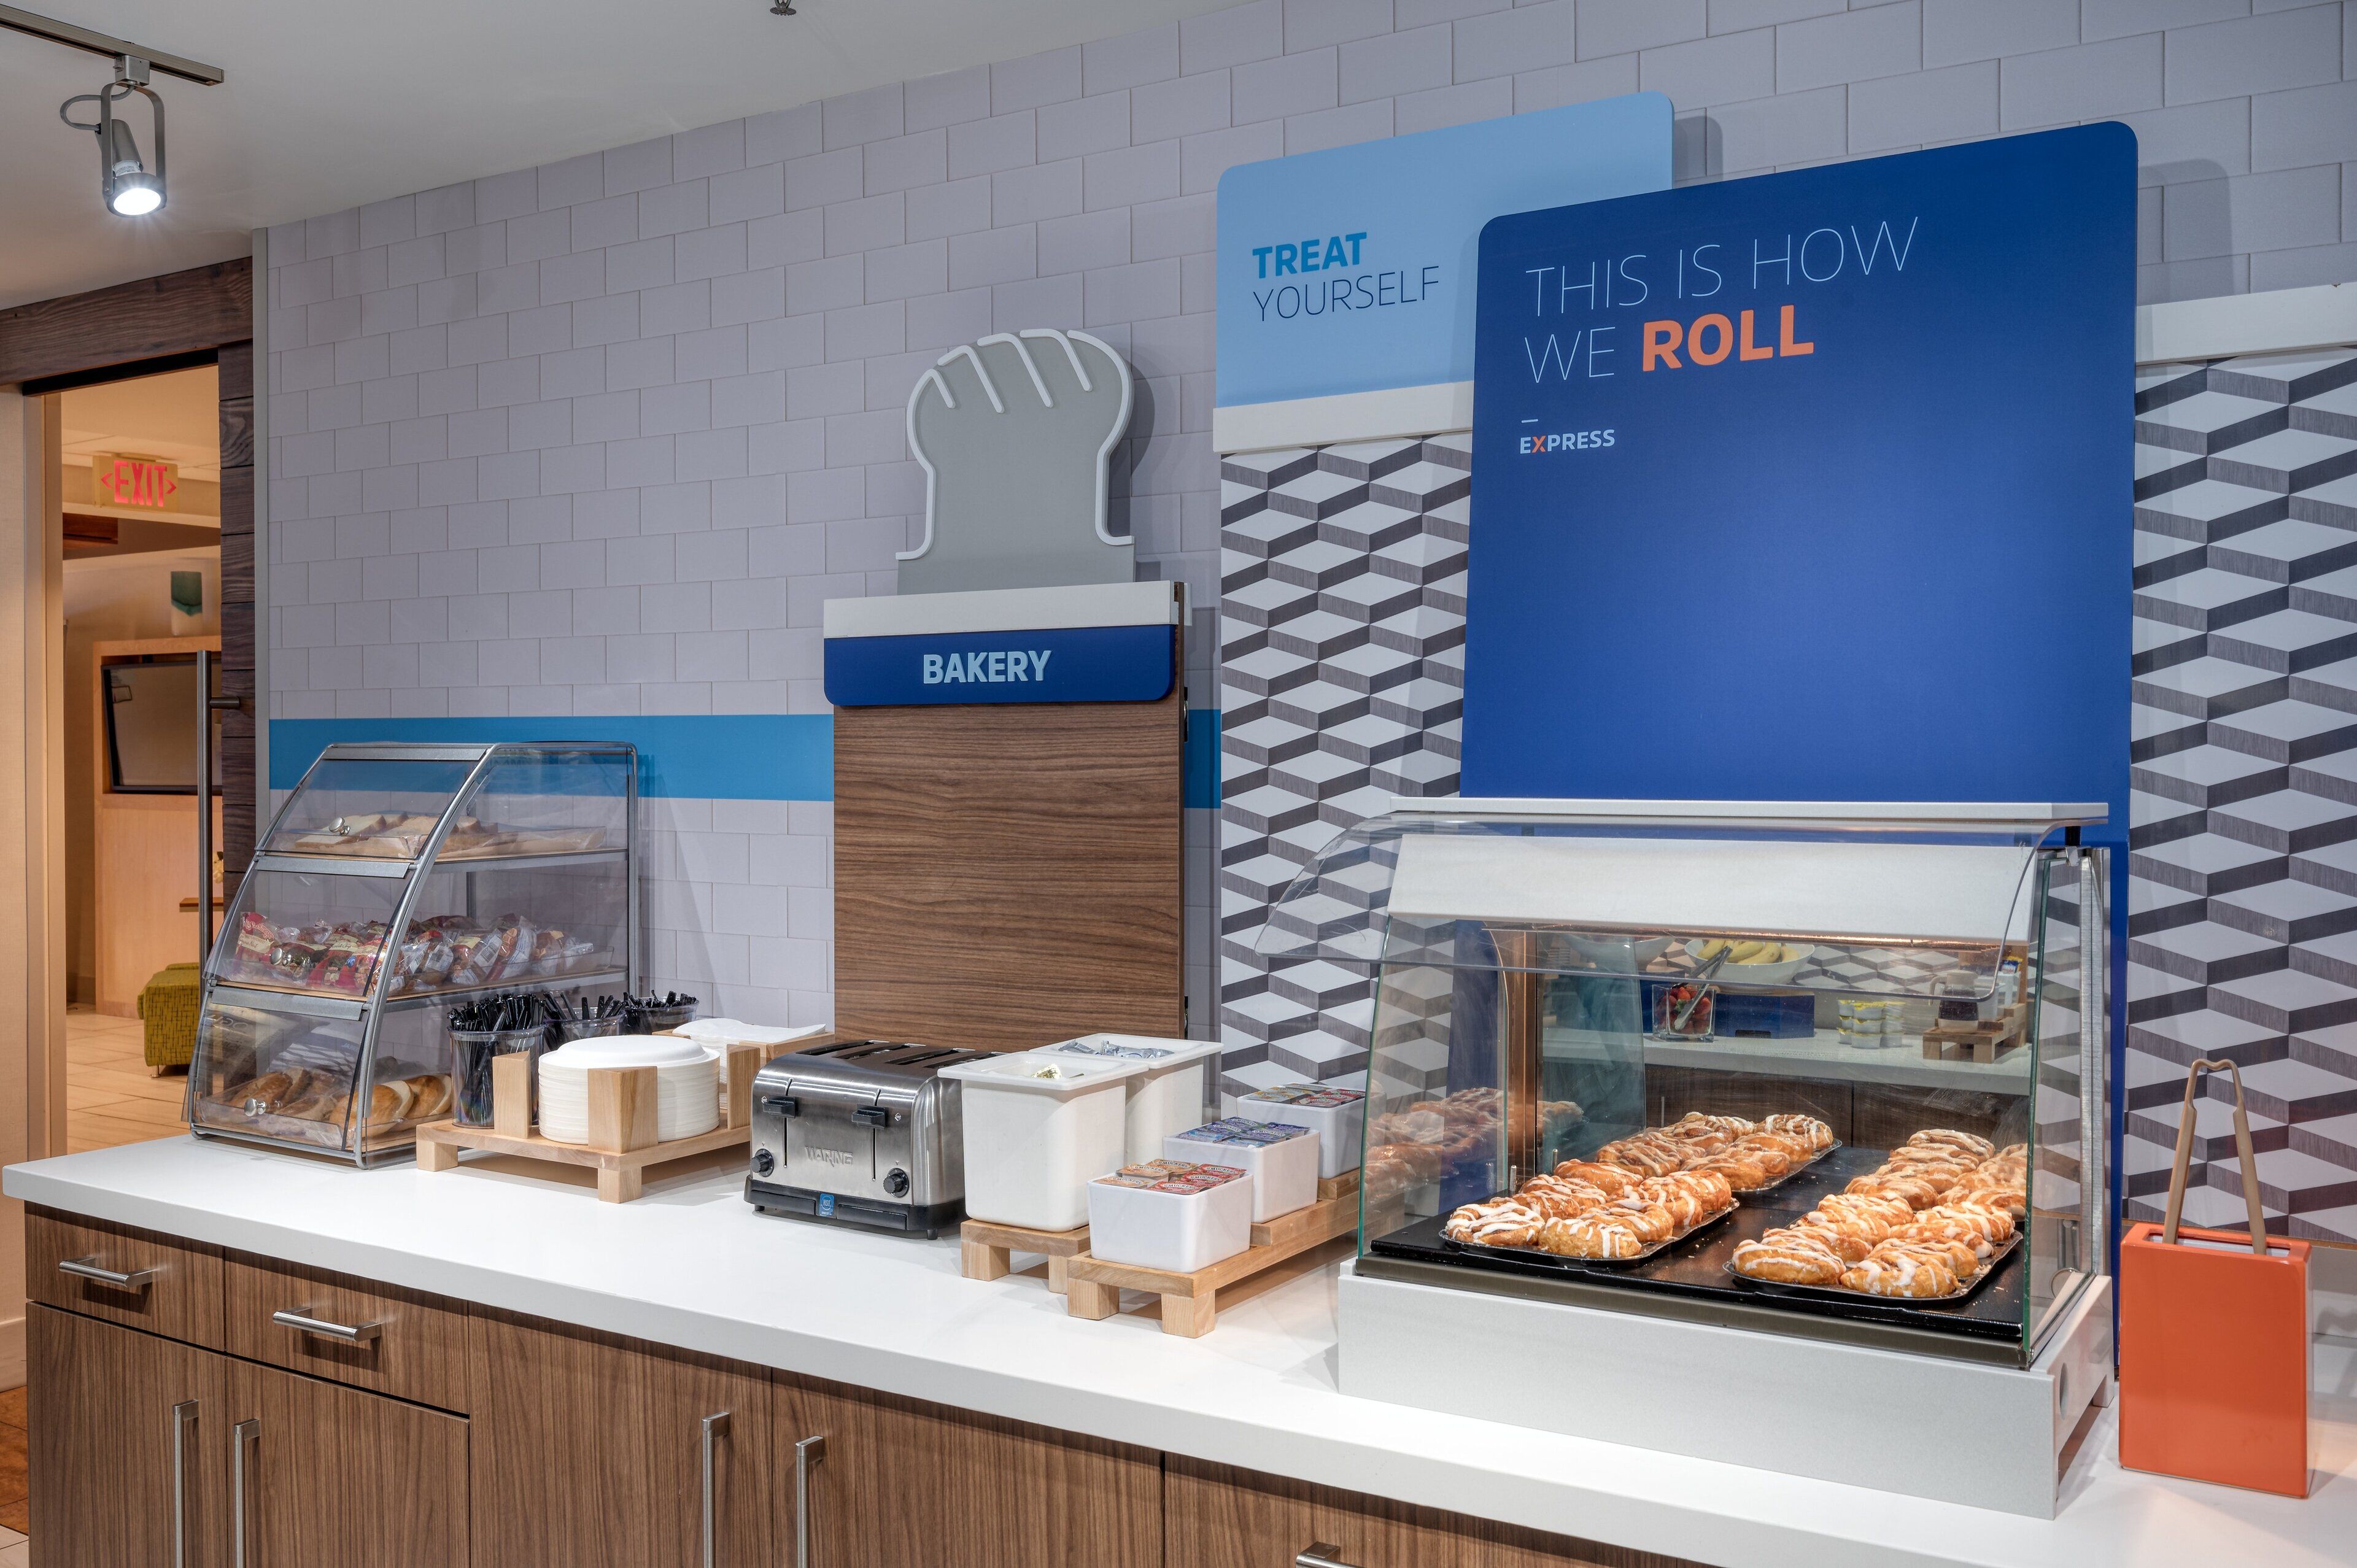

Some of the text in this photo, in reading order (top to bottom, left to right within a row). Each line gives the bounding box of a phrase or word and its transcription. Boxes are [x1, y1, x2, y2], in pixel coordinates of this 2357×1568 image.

[1252, 232, 1367, 279] TREAT
[1525, 216, 1919, 317] THIS IS HOW
[1253, 266, 1439, 322] YOURSELF
[1524, 304, 1814, 384] WE ROLL
[1520, 429, 1616, 454] EXPRESS
[114, 460, 167, 508] EXIT
[923, 650, 1053, 684] BAKERY
[805, 1145, 853, 1167] WARING
